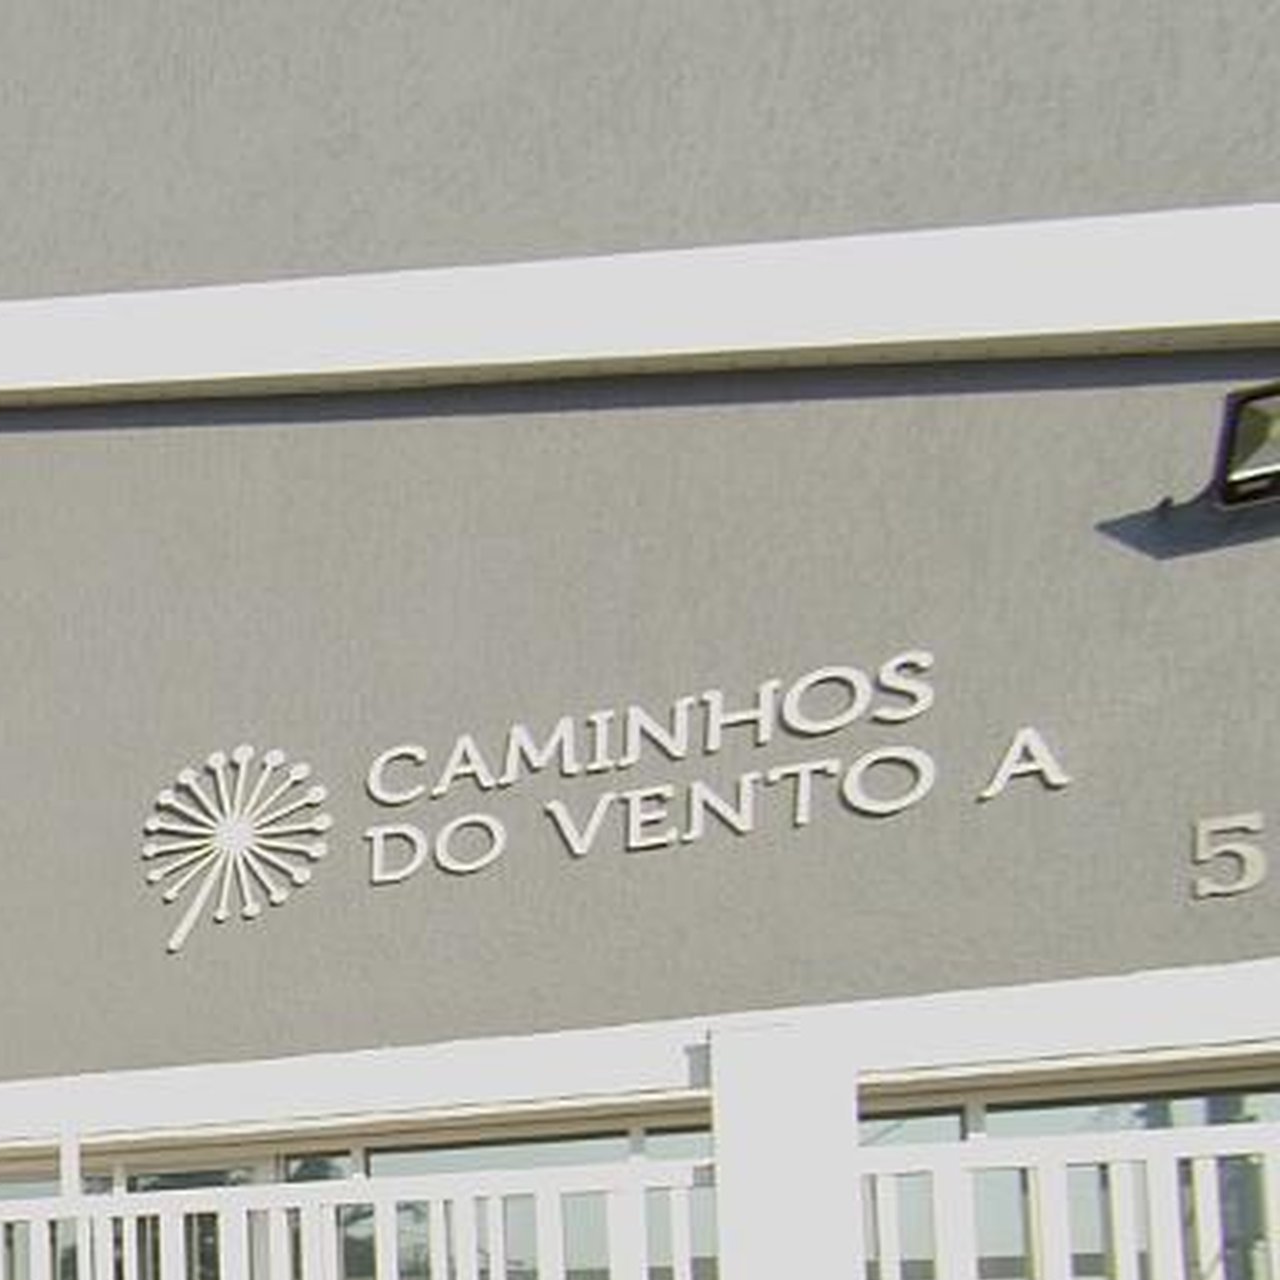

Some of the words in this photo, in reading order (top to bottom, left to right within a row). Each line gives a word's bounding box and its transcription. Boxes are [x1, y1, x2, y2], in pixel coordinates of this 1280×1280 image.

[363, 813, 507, 886] DO
[544, 745, 936, 858] VENTO
[977, 726, 1071, 802] A
[365, 648, 936, 807] CAMINHOS
[1191, 812, 1267, 900] 5
